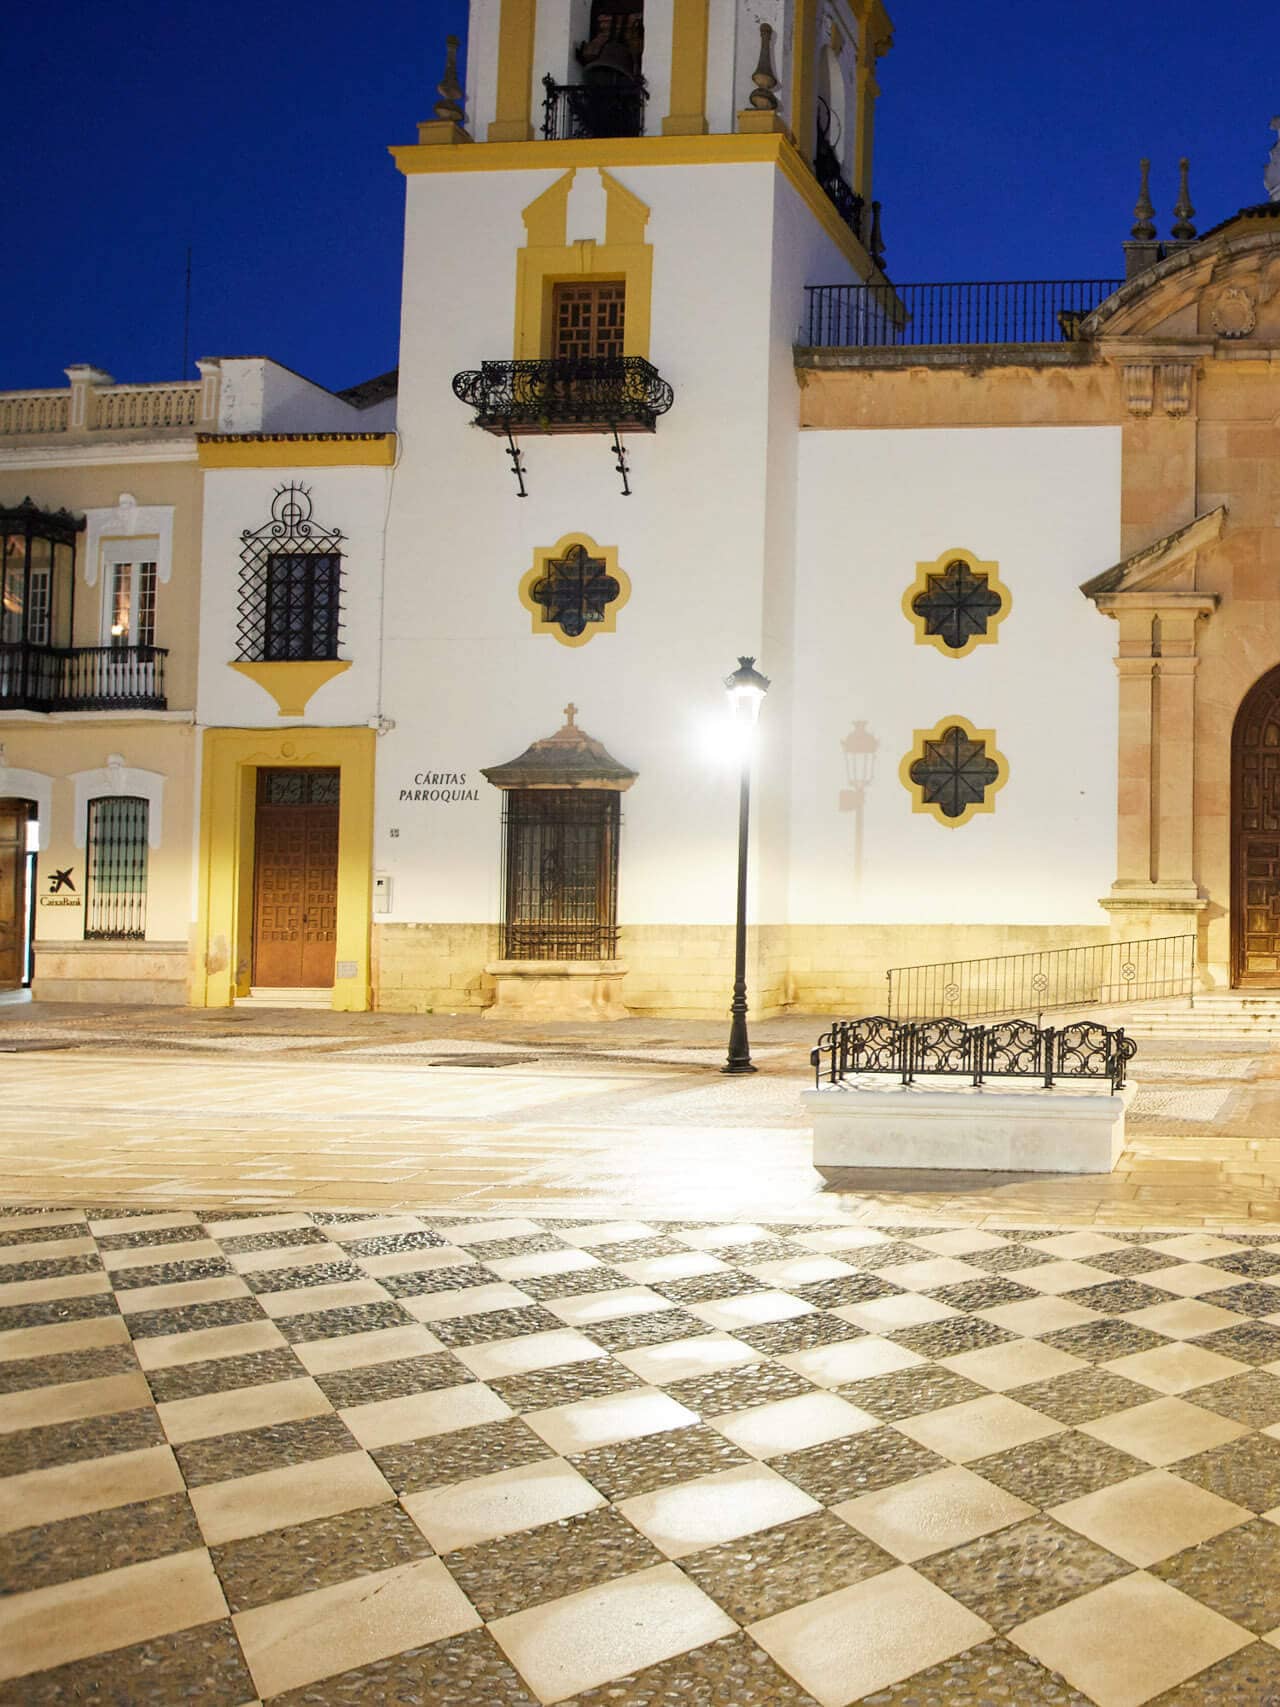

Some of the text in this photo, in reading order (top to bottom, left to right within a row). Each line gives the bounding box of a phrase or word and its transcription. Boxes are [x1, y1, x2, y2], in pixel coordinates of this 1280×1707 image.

[414, 770, 466, 785] CÁRITAS
[399, 789, 480, 803] PARROQUIAL
[40, 896, 81, 906] CaixaBank
